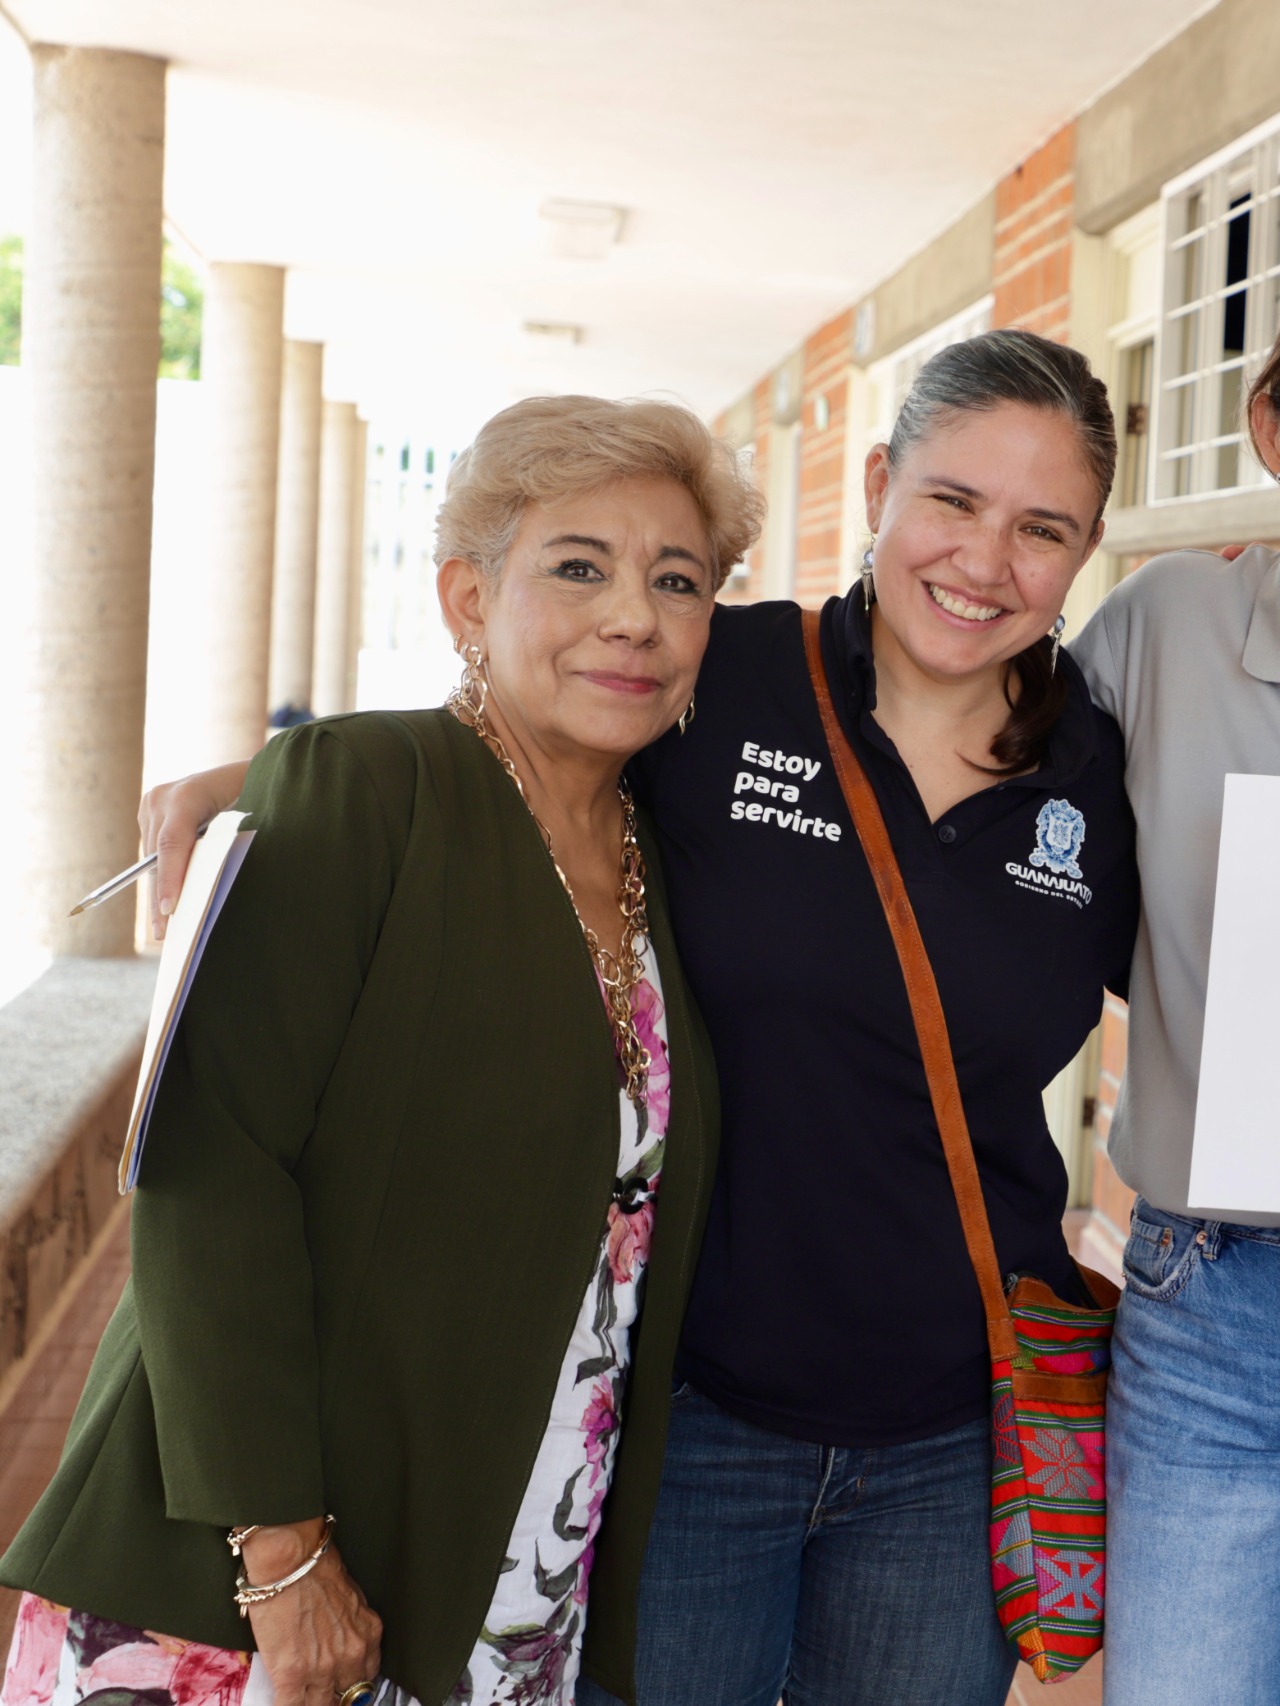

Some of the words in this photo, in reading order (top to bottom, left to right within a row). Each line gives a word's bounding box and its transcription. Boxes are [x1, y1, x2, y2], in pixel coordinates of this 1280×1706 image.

[742, 741, 821, 781] Estoy
[734, 772, 800, 803] para
[730, 801, 842, 842] servirte
[1005, 862, 1092, 905] GUANAJUATO
